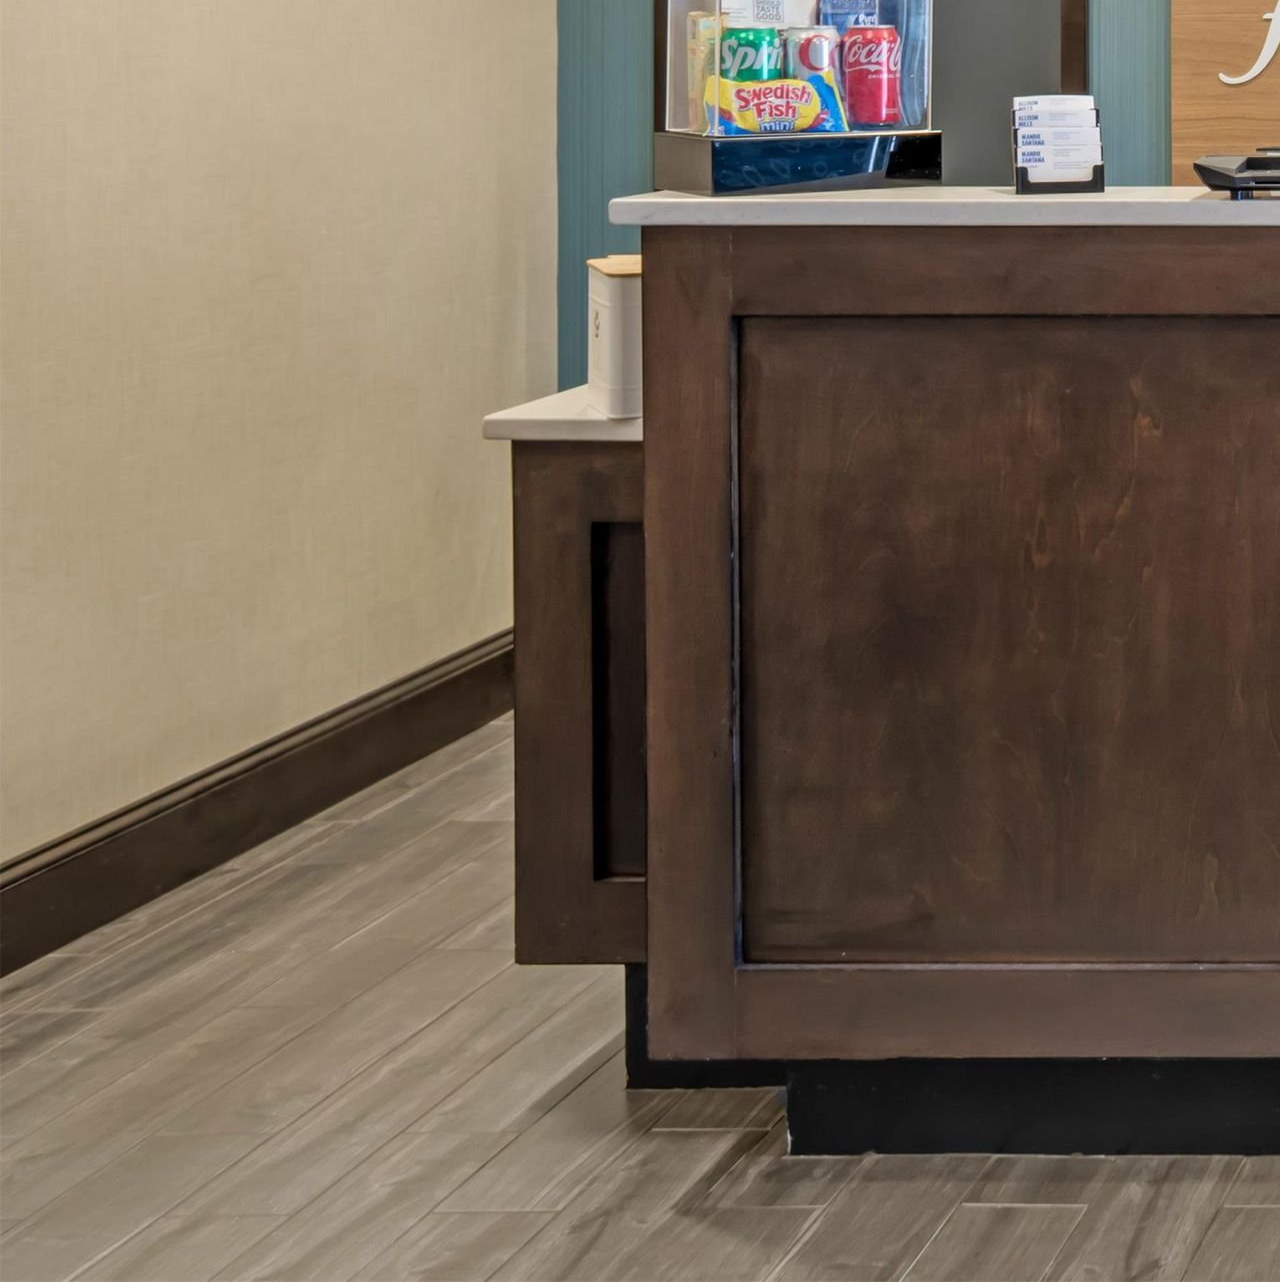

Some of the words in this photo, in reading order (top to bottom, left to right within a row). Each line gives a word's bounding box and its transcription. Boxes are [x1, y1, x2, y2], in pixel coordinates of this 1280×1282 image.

[734, 83, 812, 110] Swedish
[752, 100, 798, 119] Fish
[760, 120, 794, 132] mini
